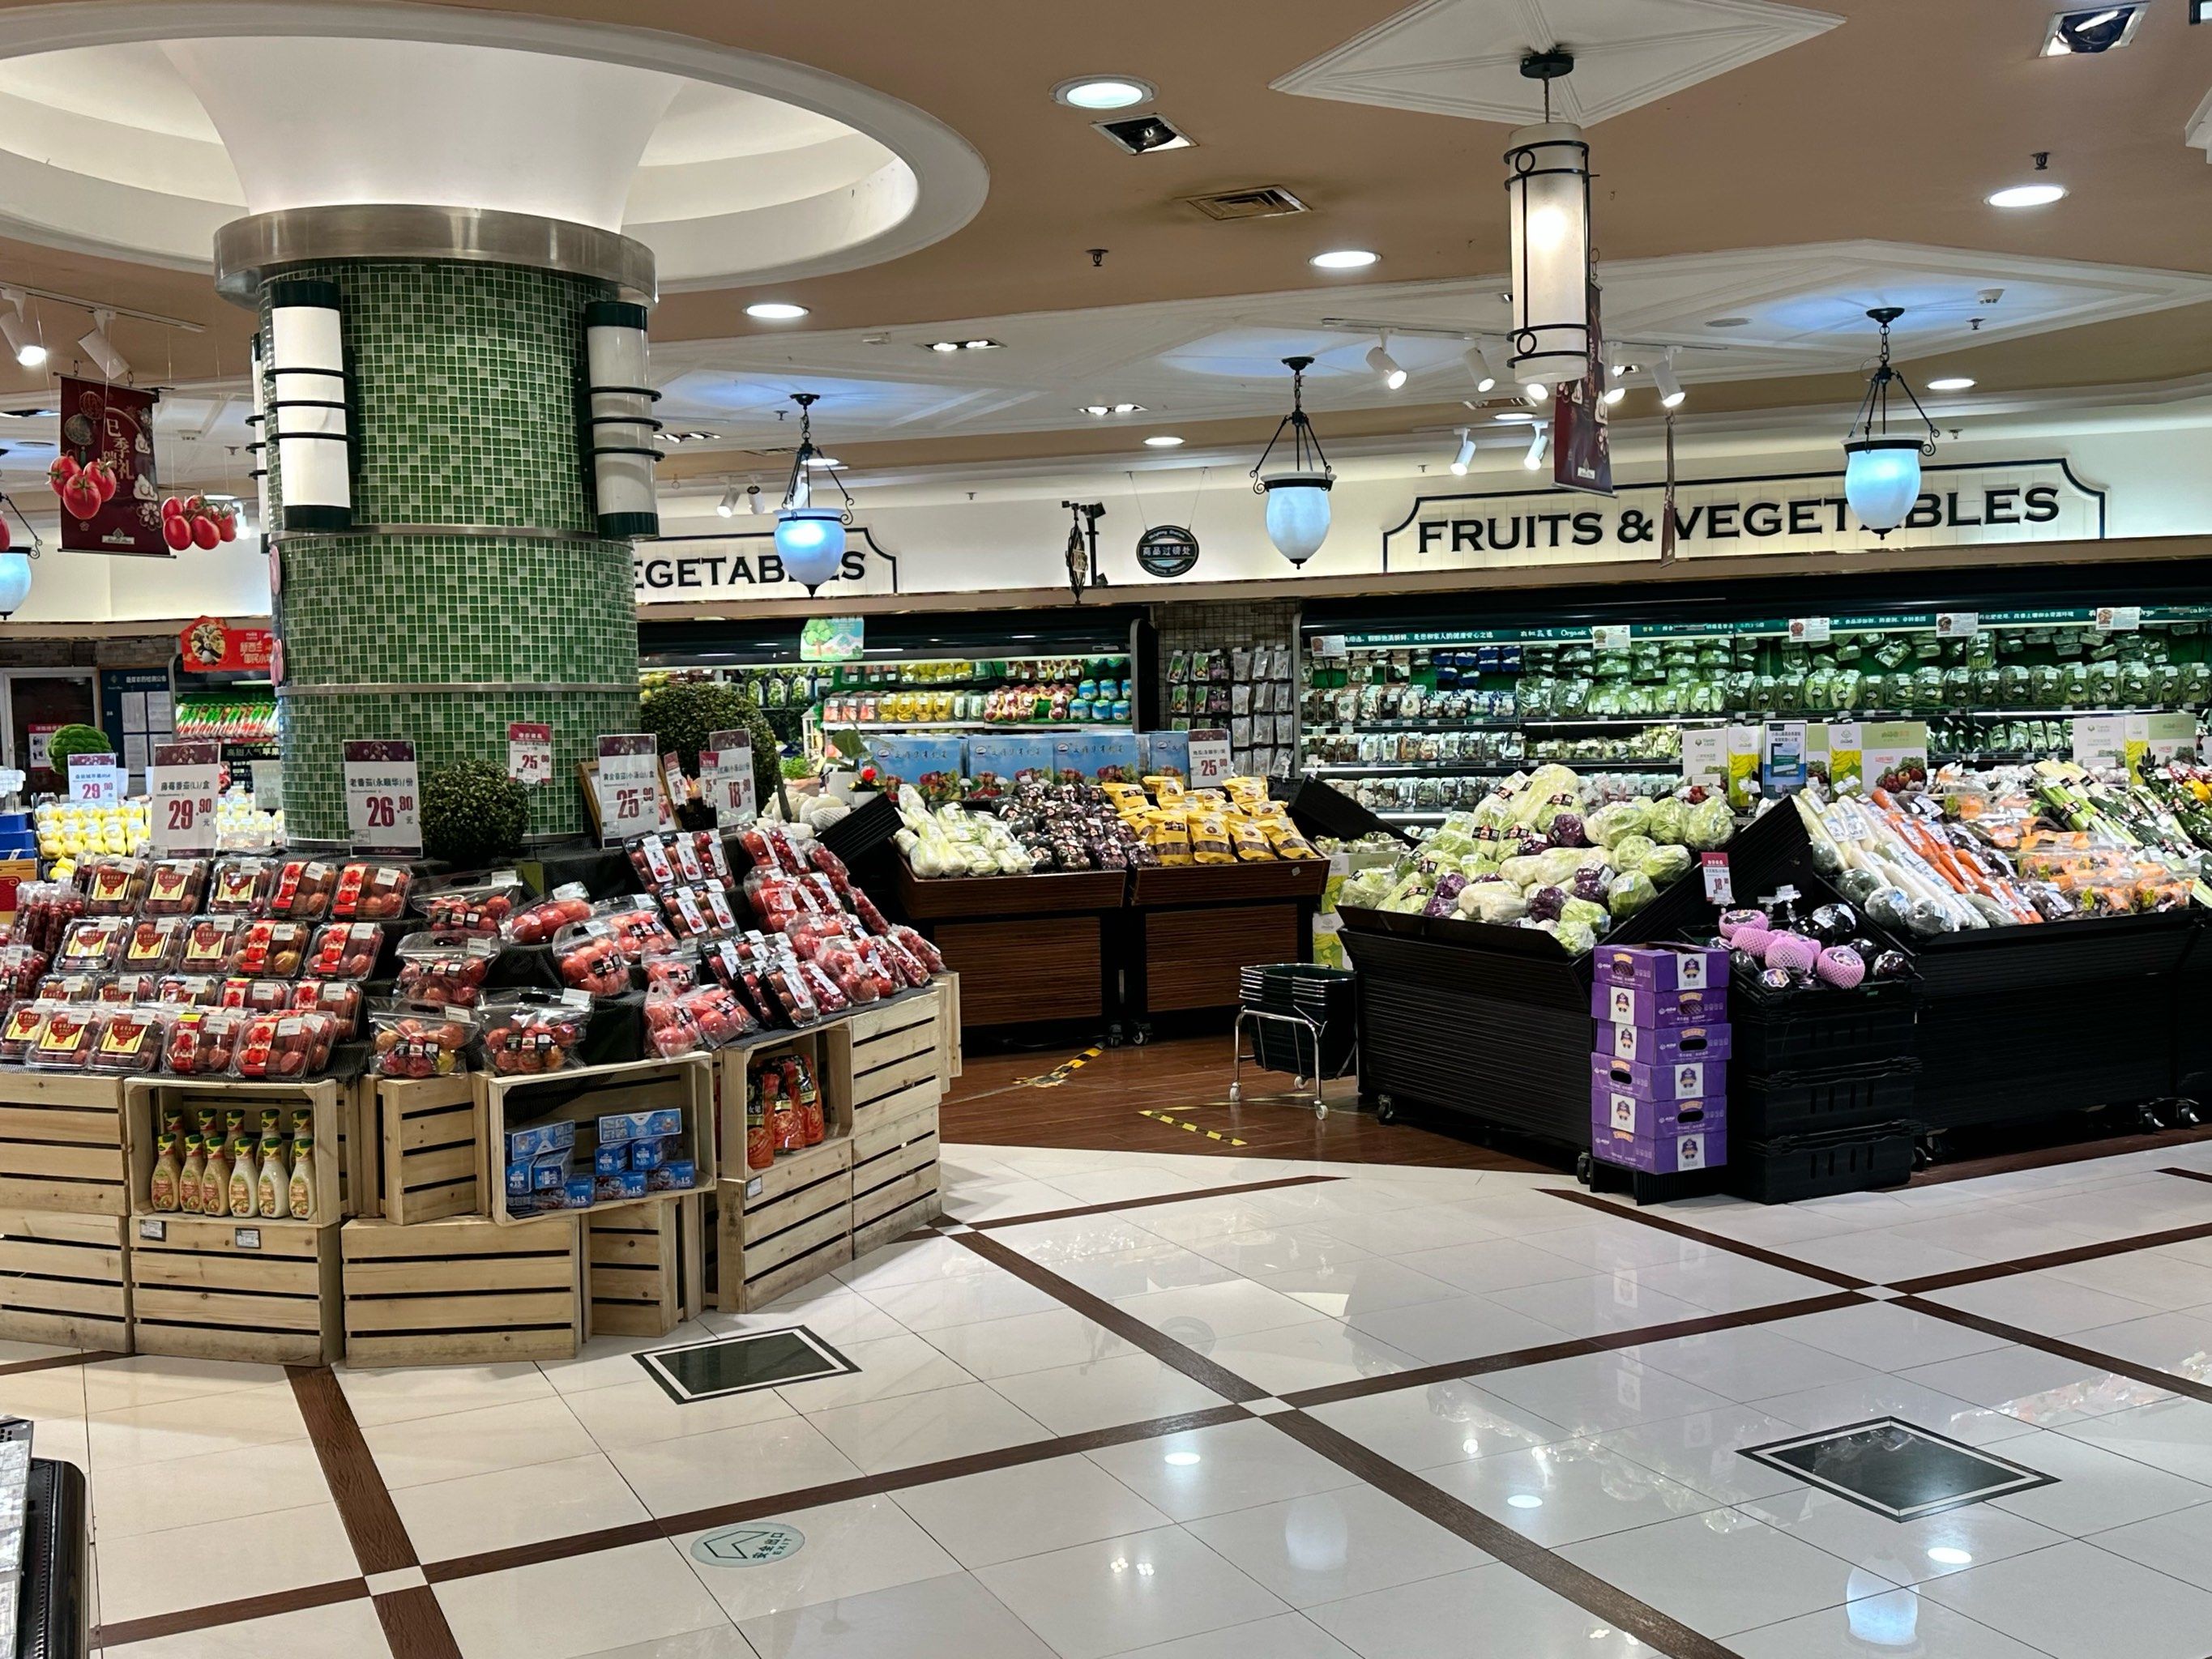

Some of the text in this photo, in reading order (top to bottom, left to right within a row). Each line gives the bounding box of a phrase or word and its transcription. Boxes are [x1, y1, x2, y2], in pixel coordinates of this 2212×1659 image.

[1418, 486, 2060, 554] FRUITS & VEGETBLES
[1142, 545, 1191, 557] 商品过磅处
[1561, 628, 1586, 638] Organic
